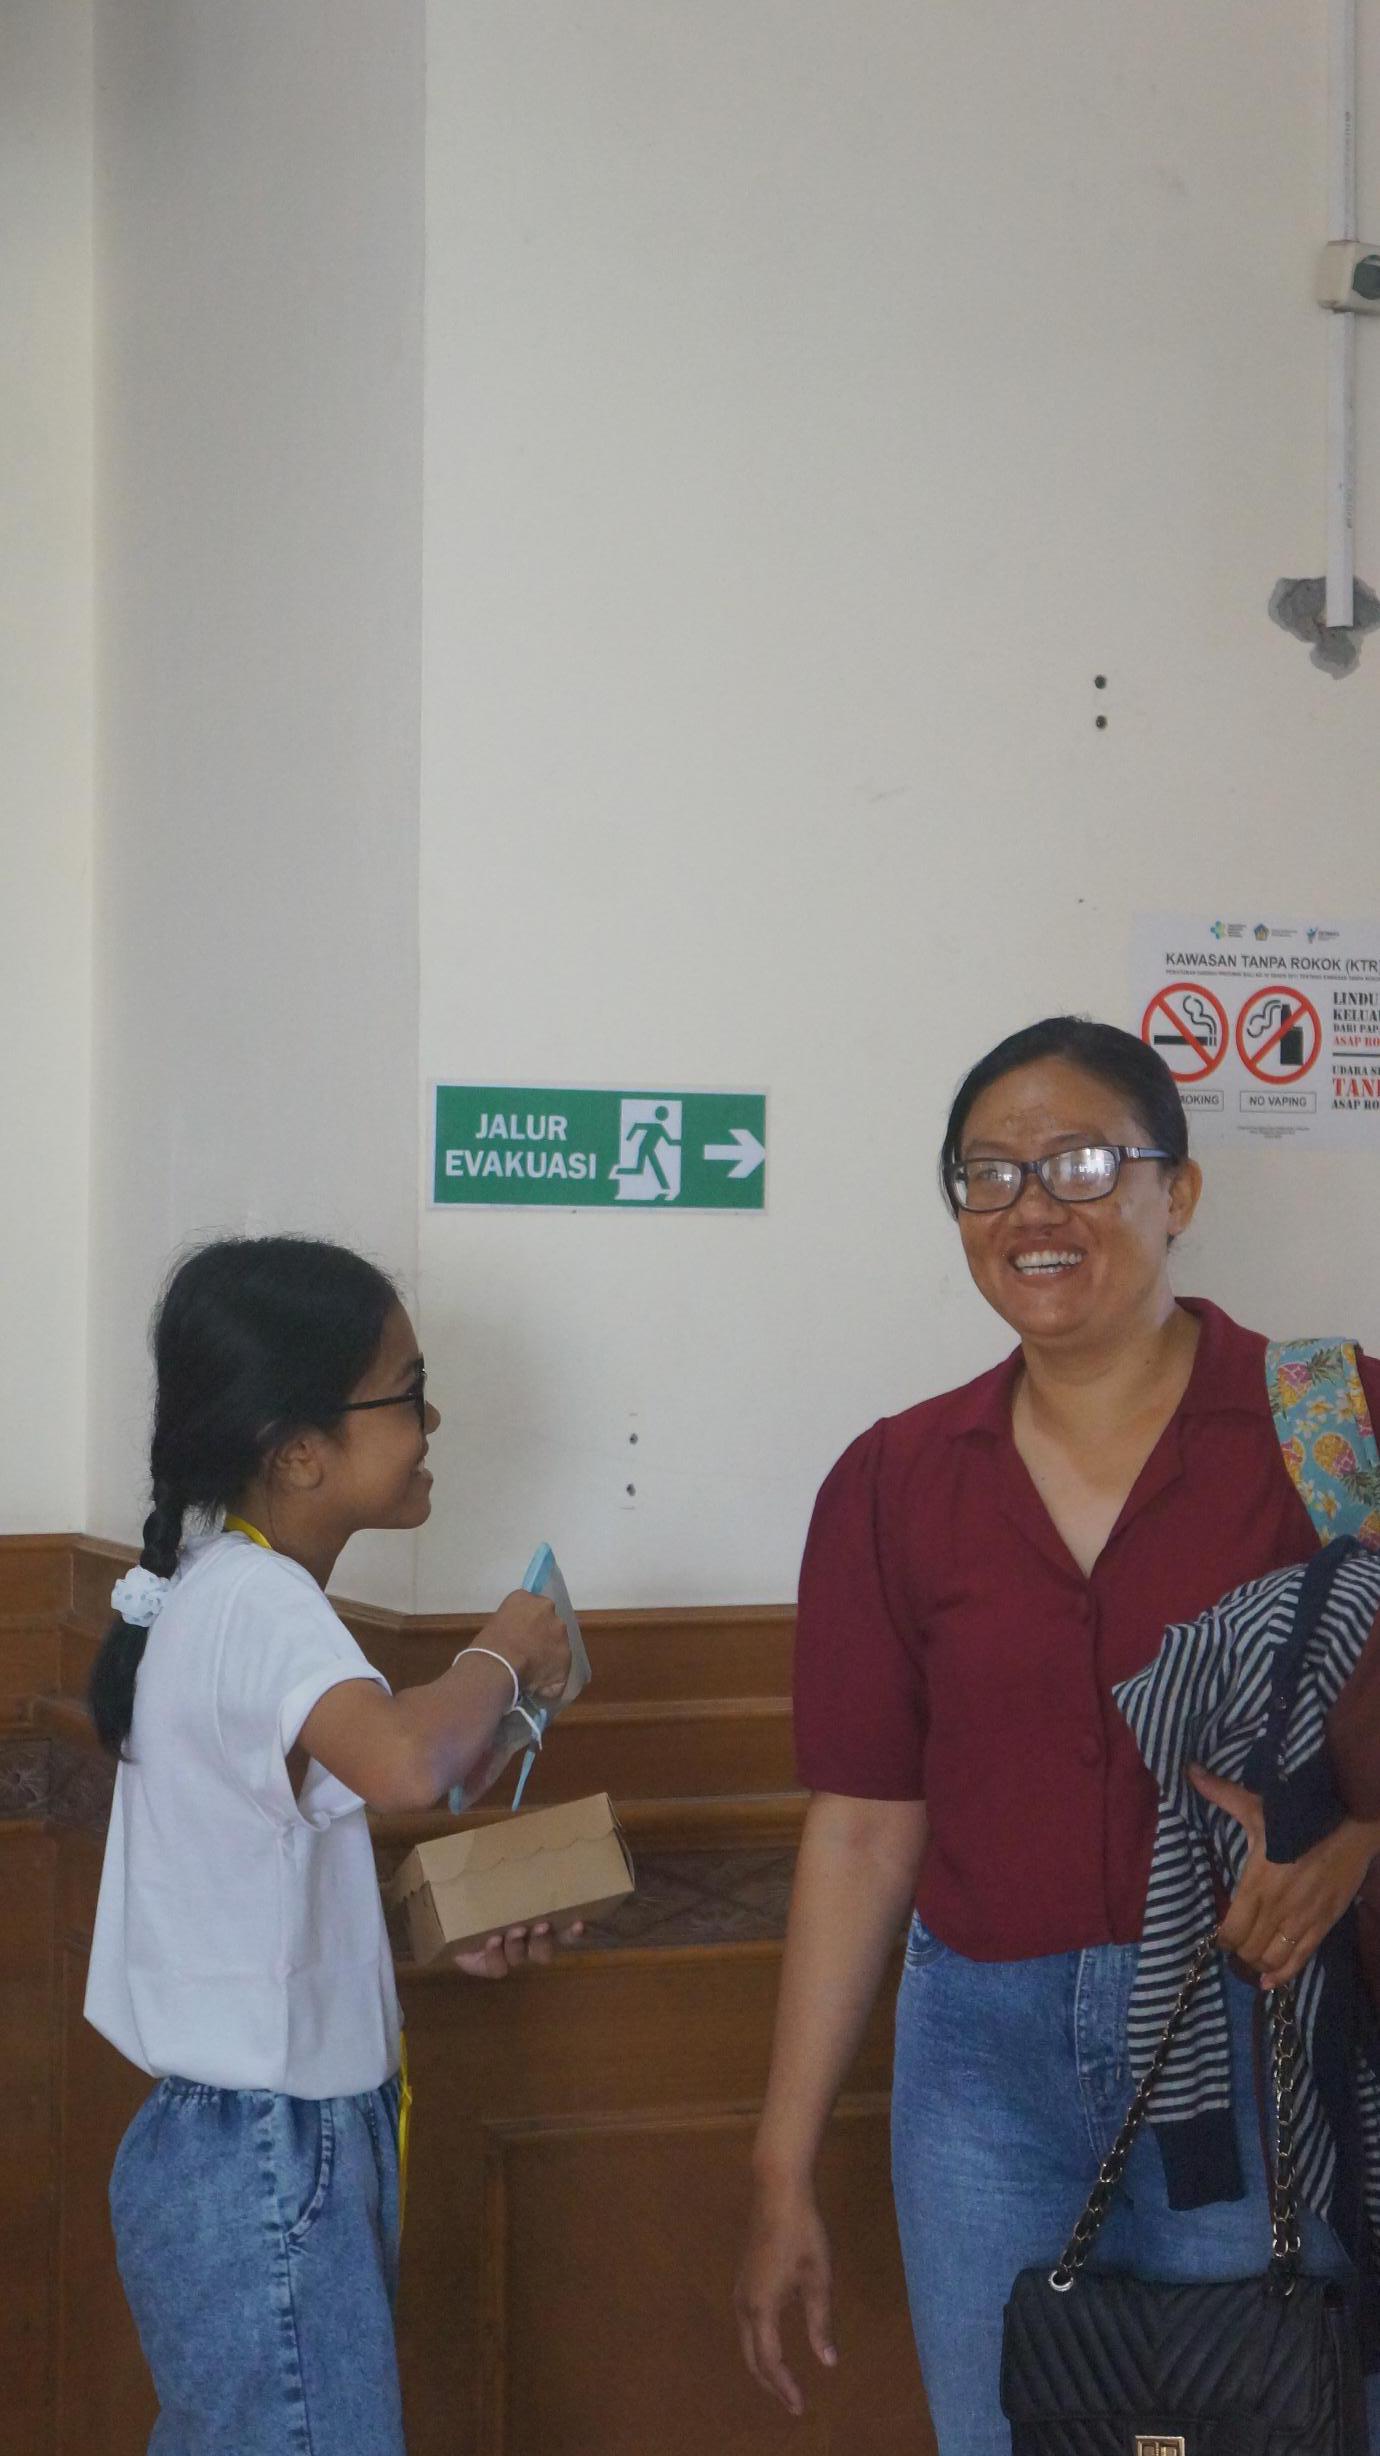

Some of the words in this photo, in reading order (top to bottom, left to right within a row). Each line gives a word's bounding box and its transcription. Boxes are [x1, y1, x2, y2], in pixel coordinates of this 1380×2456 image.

[1165, 952, 1237, 968] KAWASAN
[1241, 955, 1286, 969] TANPA
[1290, 956, 1342, 971] ROKOK
[1333, 1008, 1380, 1021] KELUA
[1333, 1023, 1357, 1033] DARI
[1360, 1024, 1380, 1034] PAP
[1333, 1035, 1361, 1047] ASAP
[1332, 1064, 1369, 1076] UDARA
[1180, 1094, 1219, 1105] OKING
[1249, 1095, 1265, 1106] NO
[1267, 1095, 1307, 1107] VAPING
[1332, 1099, 1361, 1110] ASAP
[475, 1113, 568, 1141] JALUR
[445, 1149, 597, 1180] EVAKUASI
